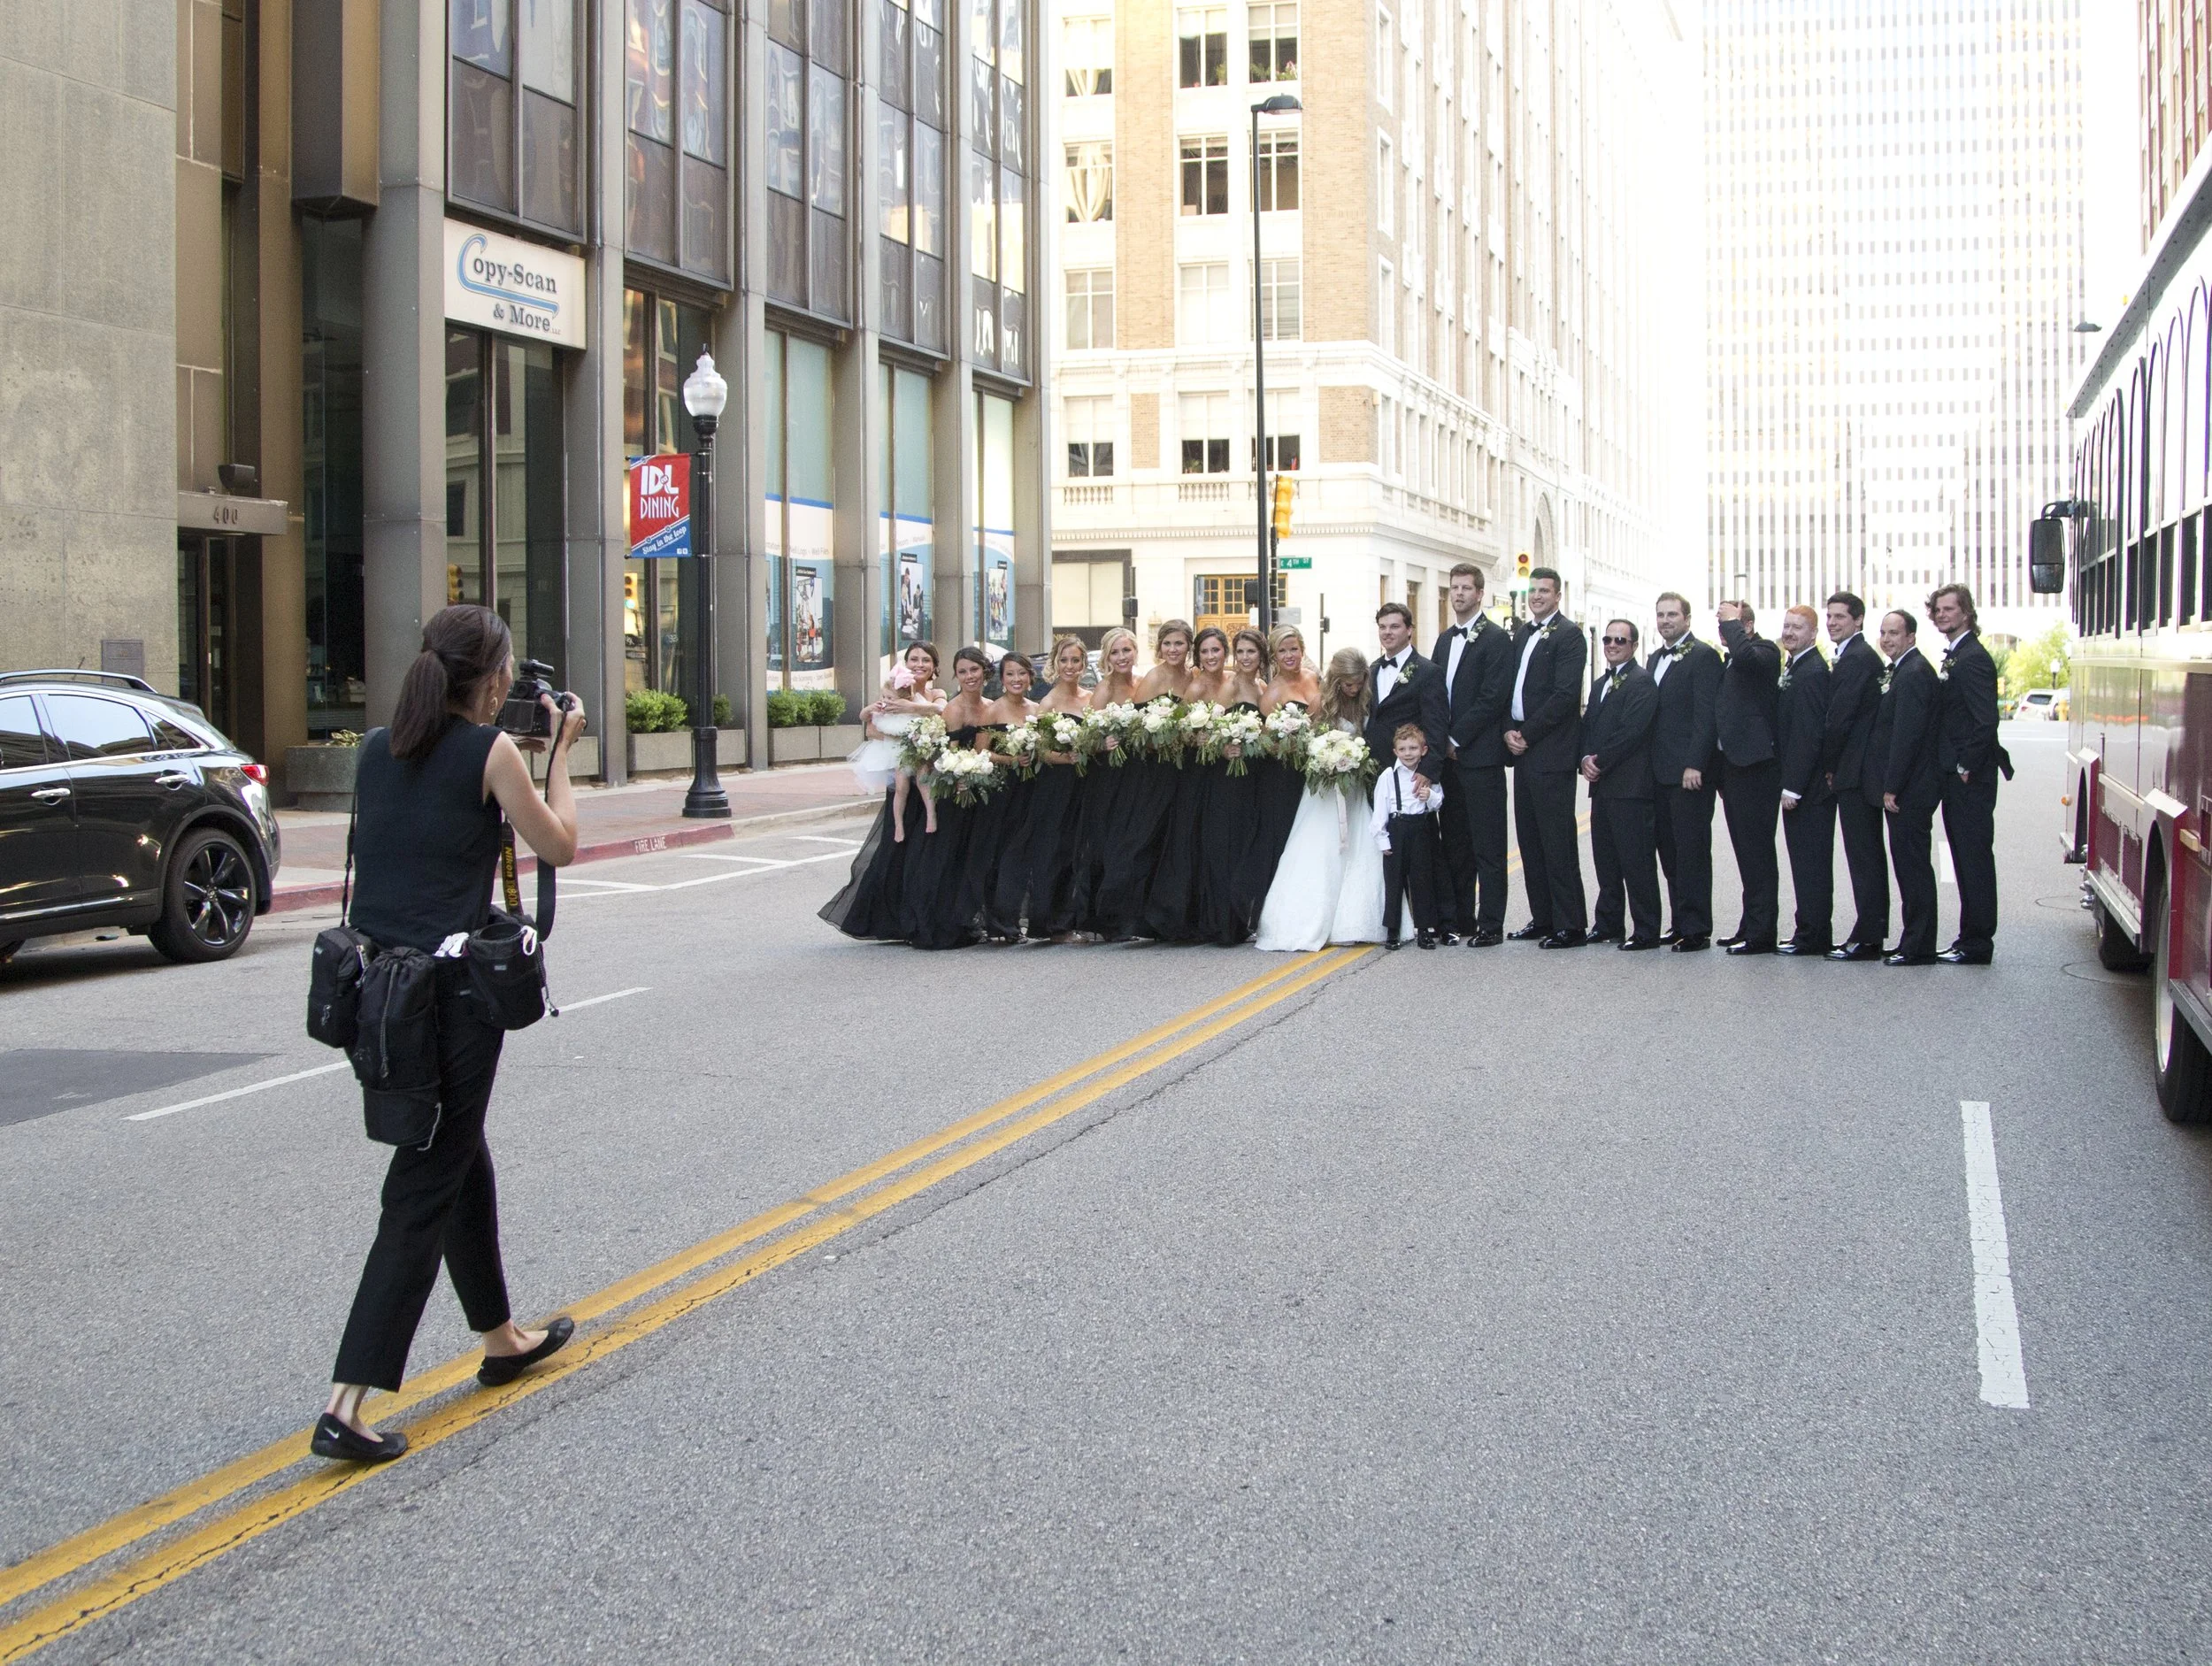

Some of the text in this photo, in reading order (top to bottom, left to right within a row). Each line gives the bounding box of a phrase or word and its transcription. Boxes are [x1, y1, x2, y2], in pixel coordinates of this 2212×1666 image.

[457, 234, 557, 294] Copy-Scan
[493, 303, 504, 319] &
[510, 304, 550, 332] More
[641, 464, 680, 495] IDL
[213, 506, 238, 525] 400
[640, 495, 680, 519] DINING
[642, 543, 657, 555] Stay
[664, 533, 673, 543] the
[673, 526, 687, 539] loop
[1286, 558, 1300, 568] 4TH
[634, 836, 667, 853] FIRE LANE
[504, 847, 514, 878] Nikon
